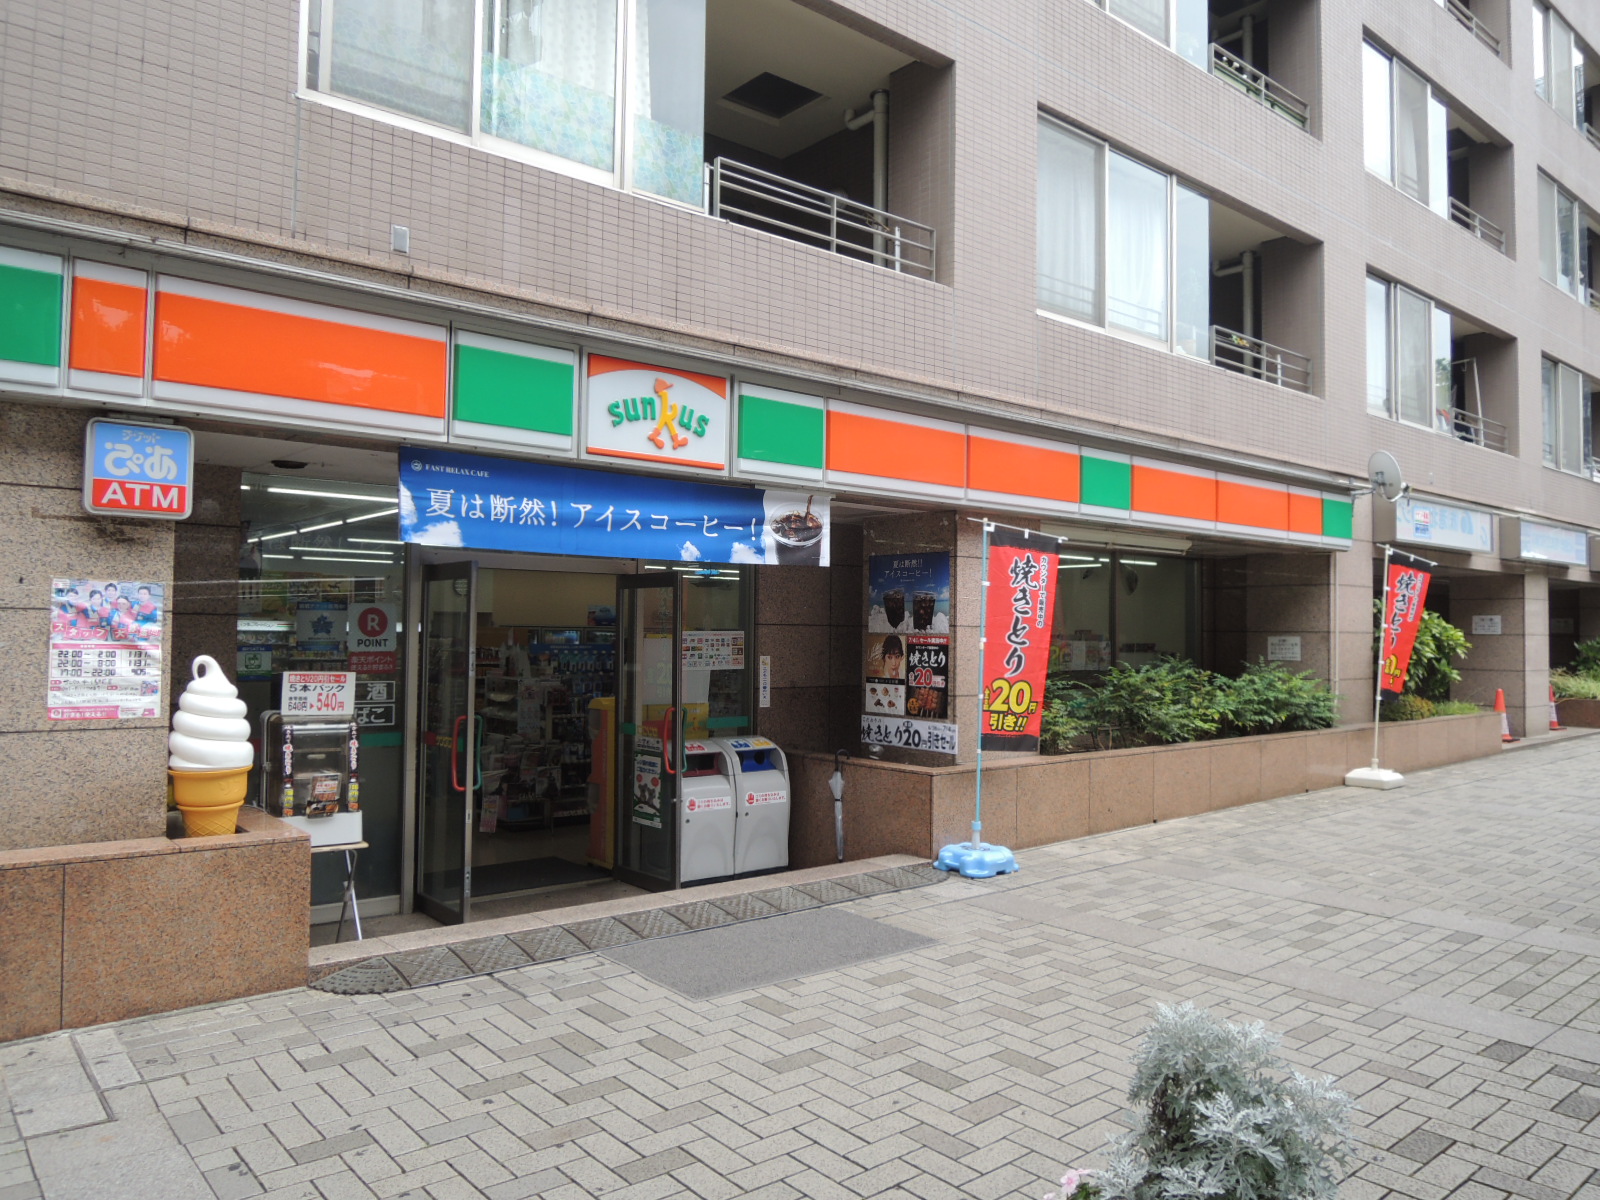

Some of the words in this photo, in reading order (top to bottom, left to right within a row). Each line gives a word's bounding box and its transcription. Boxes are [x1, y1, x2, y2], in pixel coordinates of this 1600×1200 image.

[607, 380, 710, 449] sunkus
[104, 441, 179, 480] ぴあ
[425, 463, 445, 472] FAST
[445, 466, 470, 476] RELAX
[470, 469, 490, 478] CAFE
[101, 482, 180, 509] ATM
[1004, 552, 1040, 678] 焼きとり
[357, 638, 389, 648] POINT
[909, 650, 946, 667] 焼きとり
[366, 683, 387, 700] 酒
[316, 692, 344, 711] 540円
